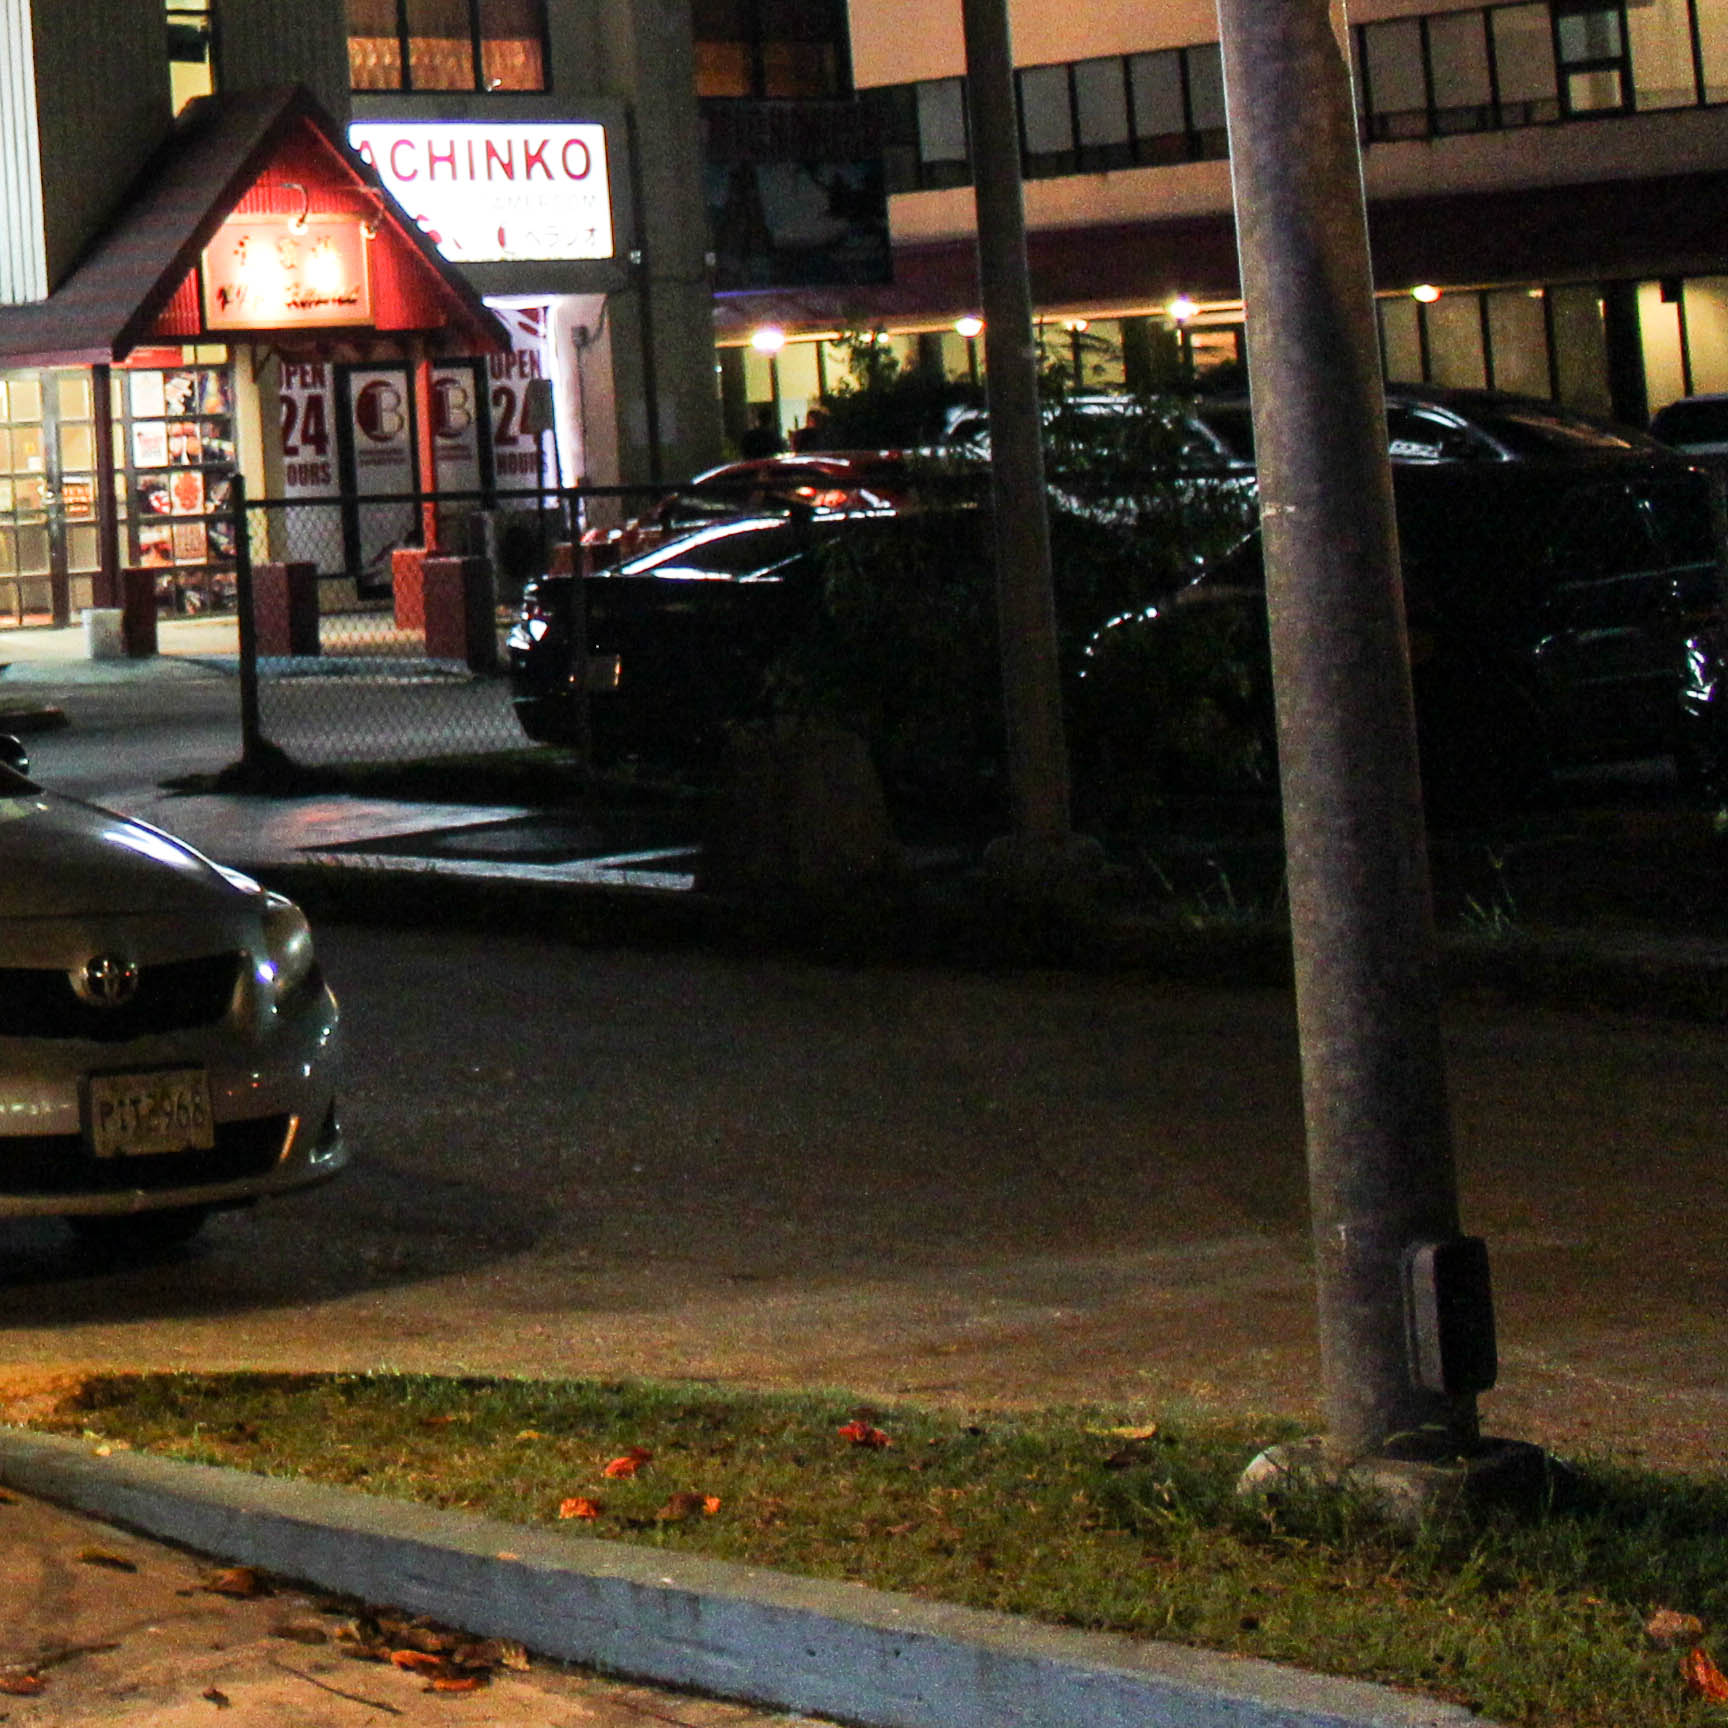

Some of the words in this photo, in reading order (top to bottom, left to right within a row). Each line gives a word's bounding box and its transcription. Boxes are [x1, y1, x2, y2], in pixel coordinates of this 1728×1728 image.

[358, 138, 592, 182] ACHINKO
[279, 363, 326, 390] PEN
[280, 394, 329, 456] 24
[286, 462, 332, 487] OURS
